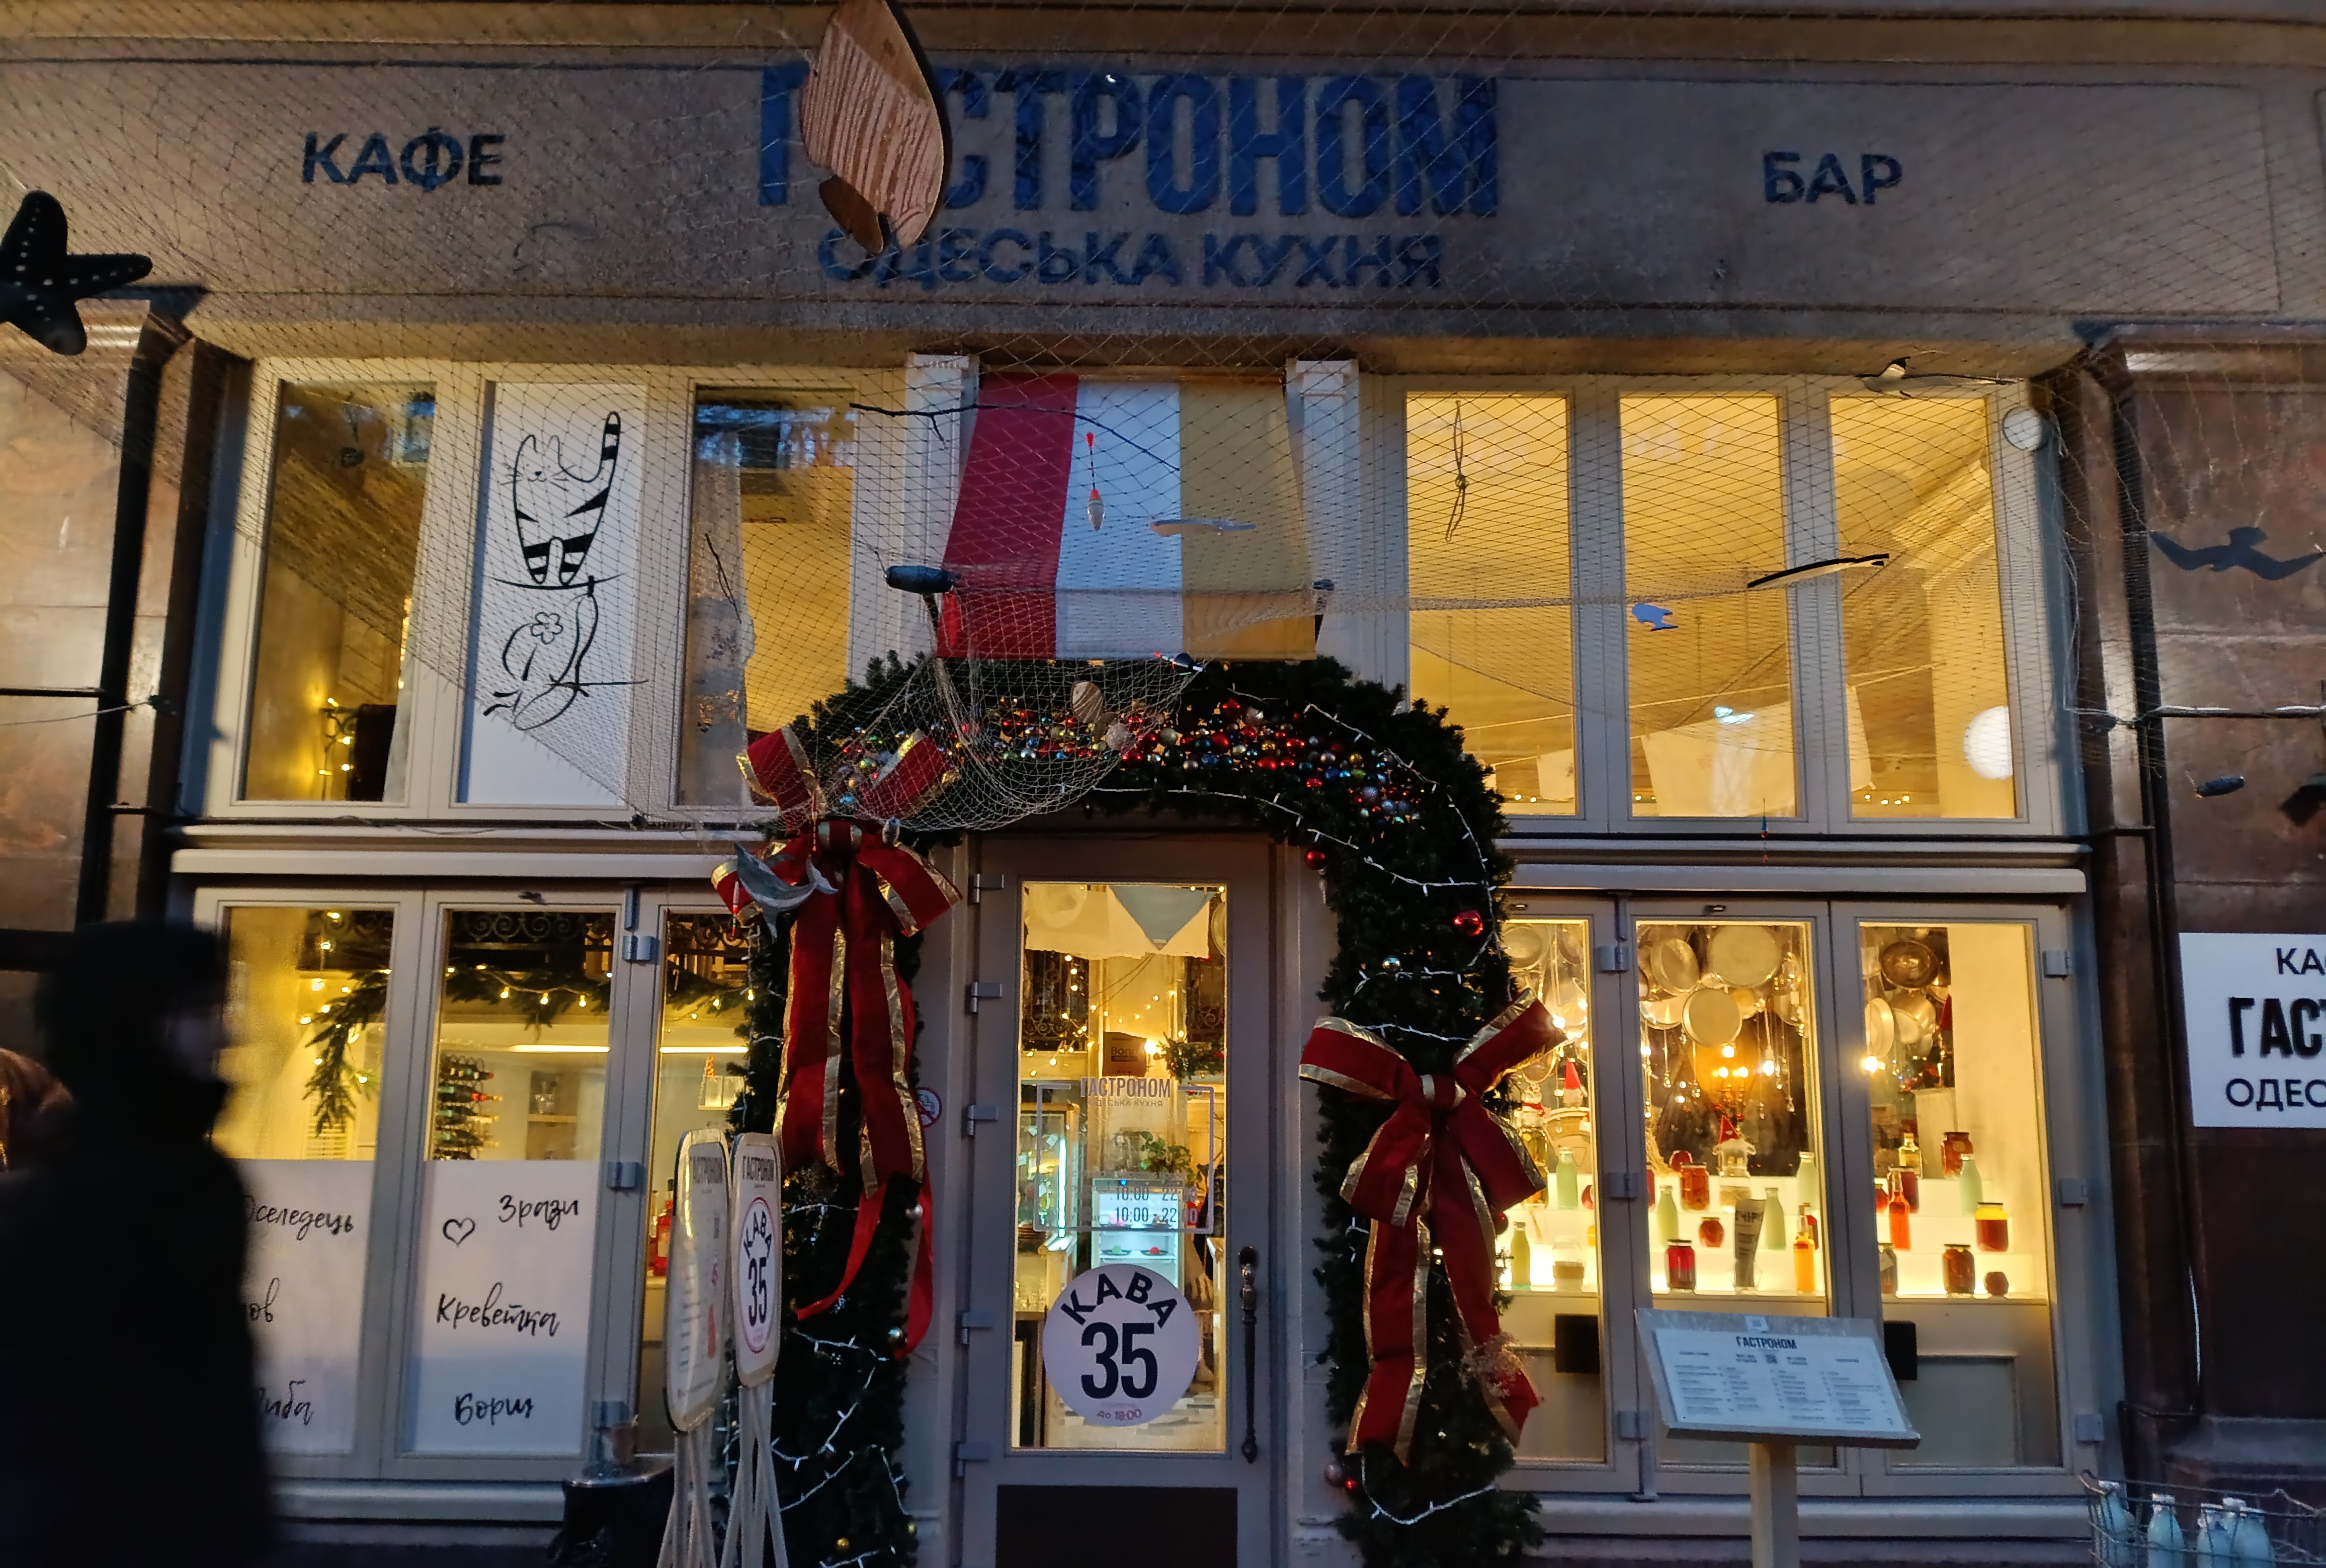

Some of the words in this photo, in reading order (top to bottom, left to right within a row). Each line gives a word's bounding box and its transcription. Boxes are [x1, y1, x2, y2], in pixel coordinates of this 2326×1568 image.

[302, 126, 505, 193] КАФЕ
[759, 61, 1499, 218] ГСТРОНОМ
[1764, 151, 1902, 204] БАР
[817, 226, 1183, 290] ОДЕСЬКА
[1203, 233, 1443, 289] КУХНЯ
[2276, 948, 2326, 975] КА
[2228, 997, 2326, 1058] ГАС
[1081, 1078, 1171, 1098] ГАСТРОНОМ
[2226, 1078, 2326, 1112] ОДЕС
[499, 1195, 578, 1230] Зрази
[744, 1210, 772, 1260] КАВА
[1117, 1207, 1149, 1222] 10:00
[436, 1282, 560, 1337] Креветка
[748, 1257, 767, 1328] 35
[1060, 1272, 1178, 1329] КАВА
[1081, 1322, 1158, 1399] 35
[1736, 1336, 1797, 1349] ГАСТРОНОМ
[455, 1392, 534, 1426] Борщ
